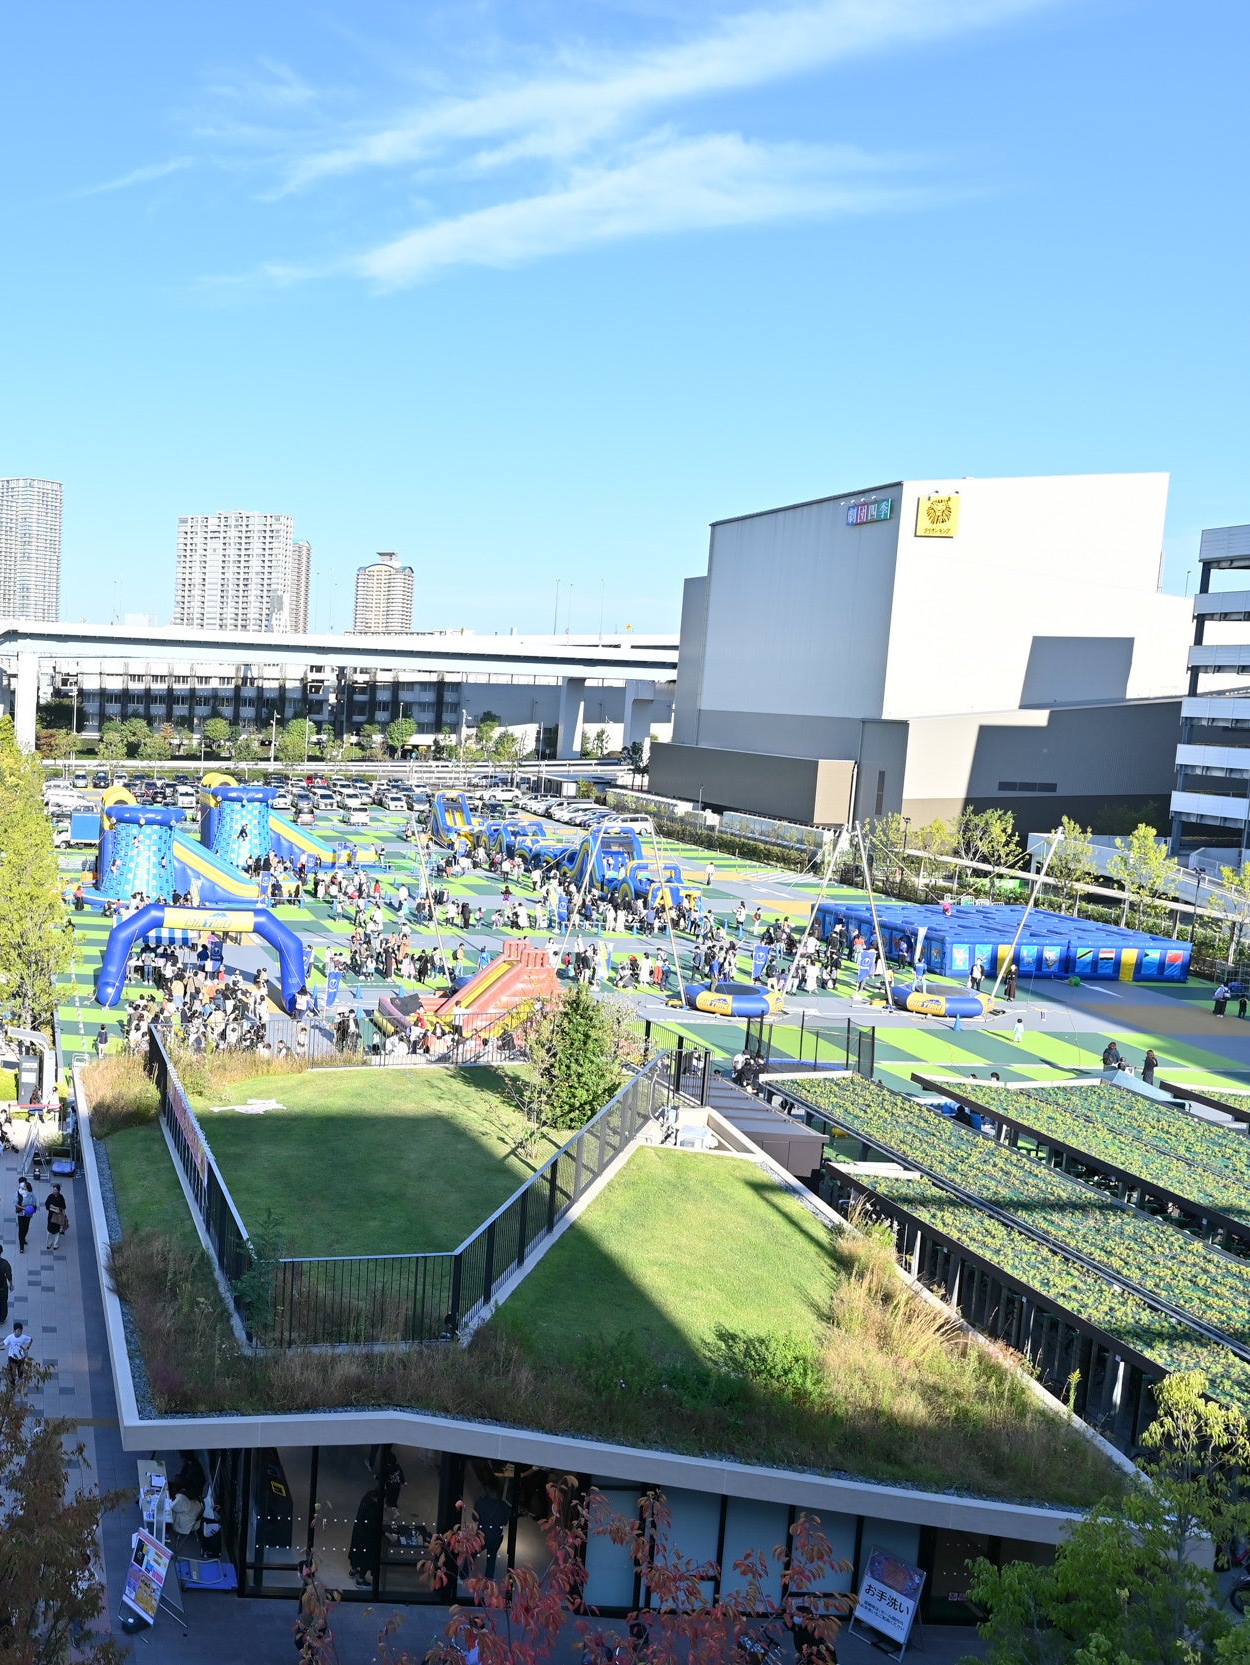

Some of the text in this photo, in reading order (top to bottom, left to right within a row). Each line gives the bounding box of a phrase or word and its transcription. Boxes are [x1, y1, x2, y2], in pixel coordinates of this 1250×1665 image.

[847, 501, 889, 524] 劇団四季
[865, 1584, 909, 1615] お手洗い
